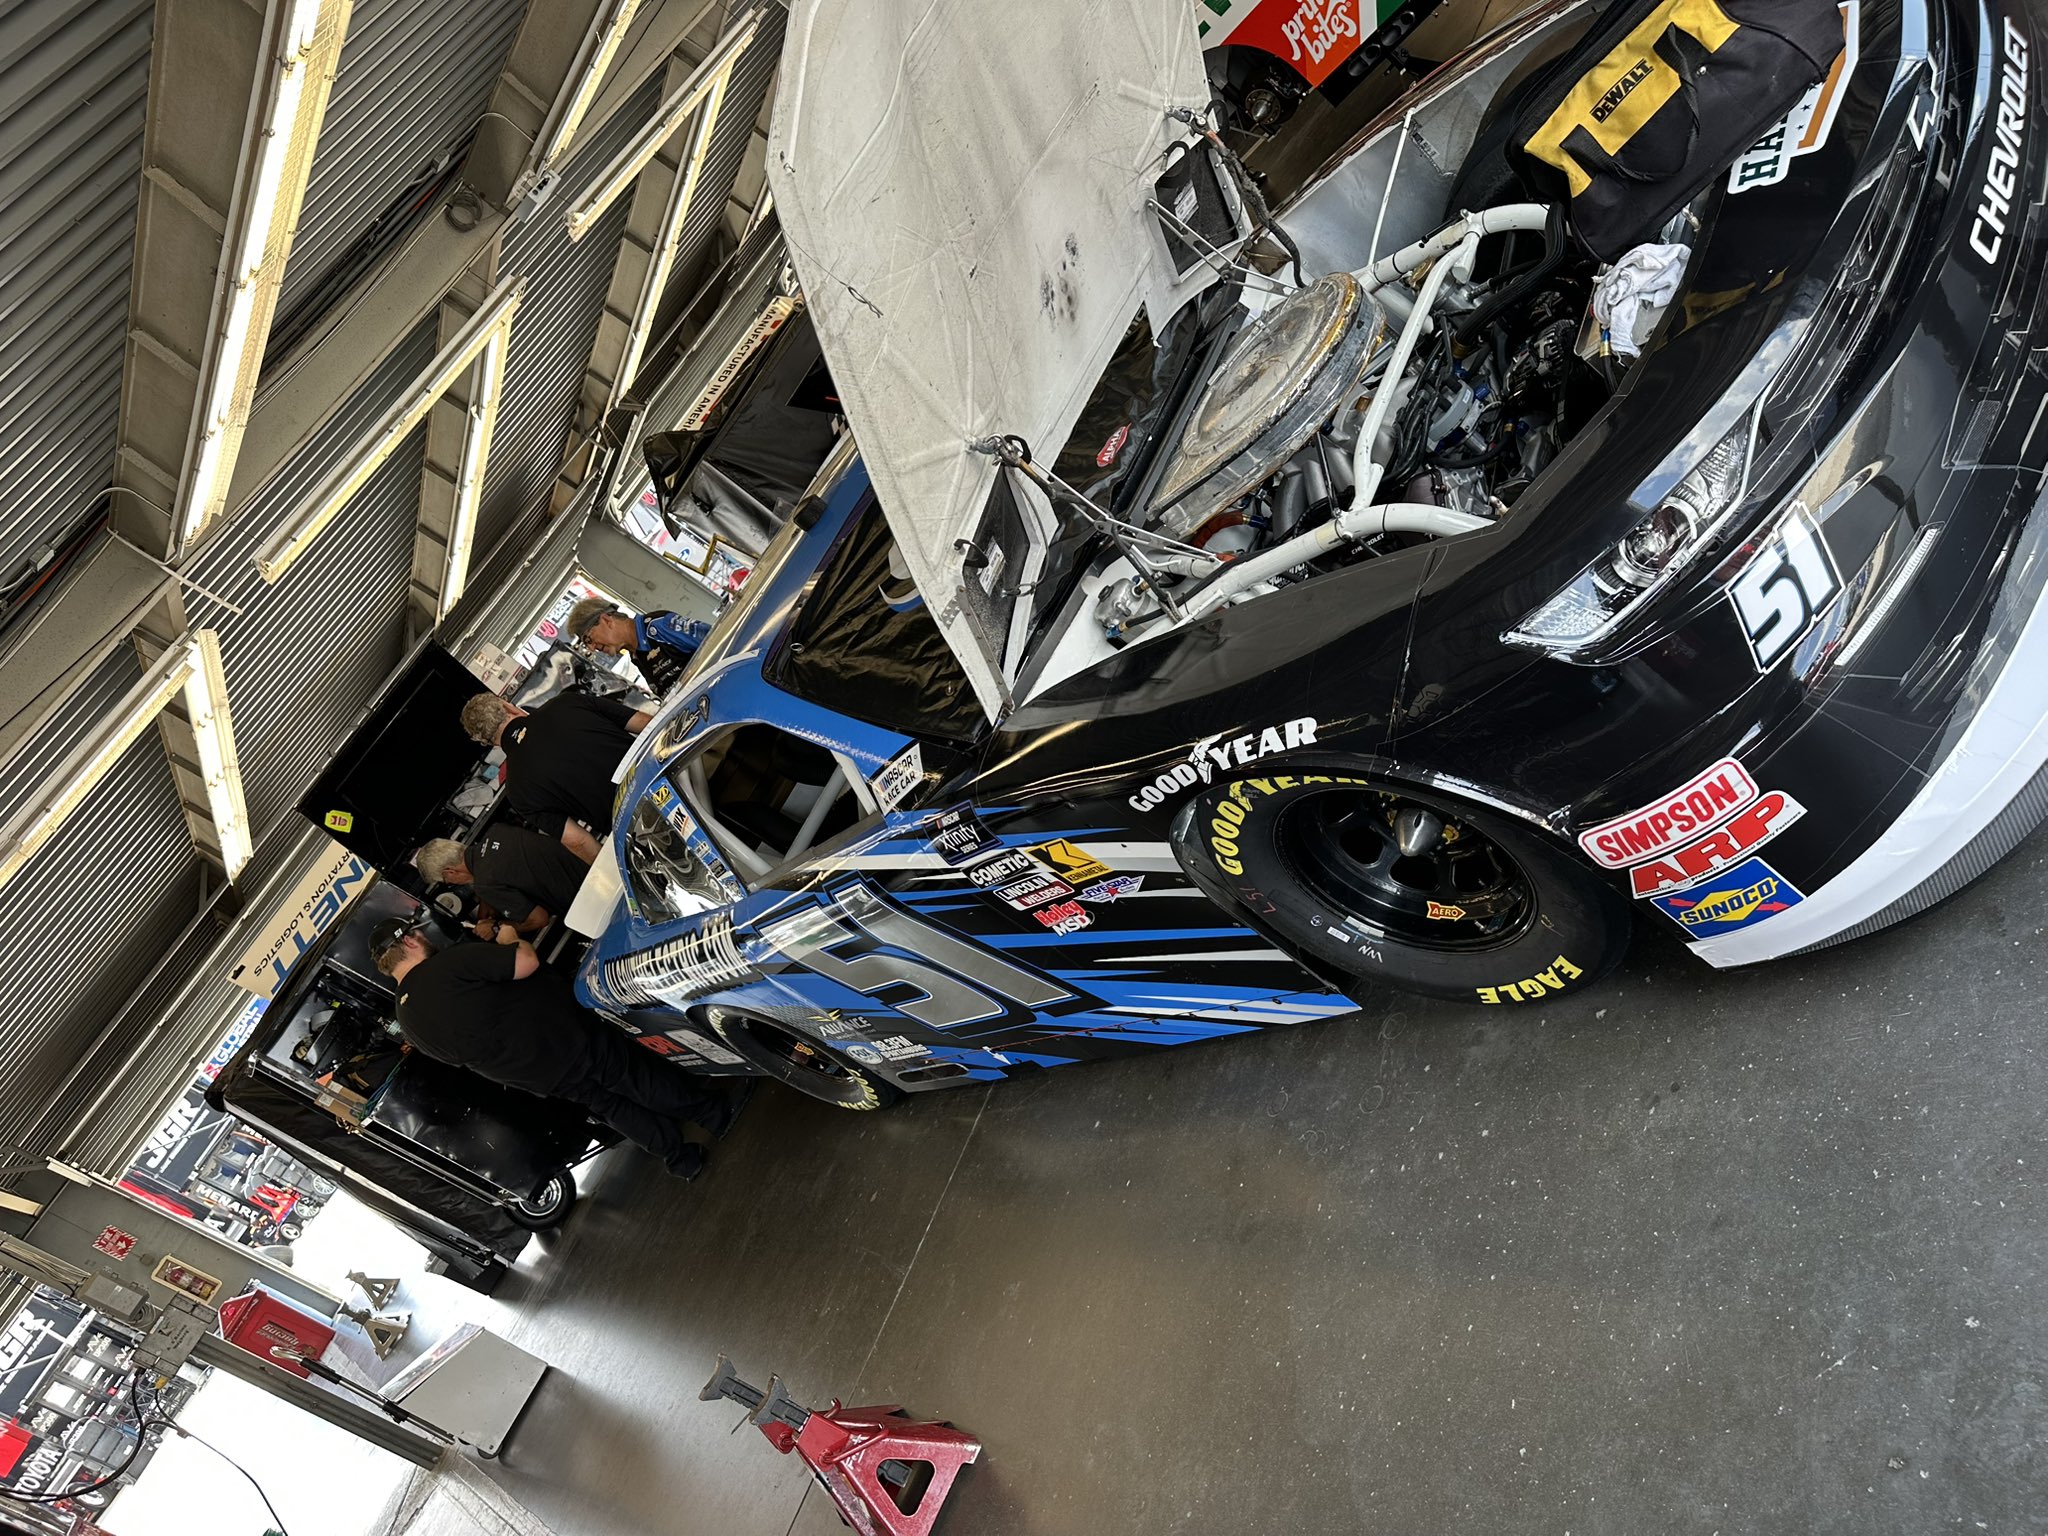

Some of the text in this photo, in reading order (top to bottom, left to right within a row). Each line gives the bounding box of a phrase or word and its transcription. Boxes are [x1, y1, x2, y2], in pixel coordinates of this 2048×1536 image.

[1301, 0, 1358, 64] bites
[1591, 58, 1654, 123] DEWALT
[1737, 114, 1789, 187] HA
[1969, 16, 2032, 265] CHEVROLET
[682, 306, 777, 431] MANUFACTURED IN AMERIC
[1101, 428, 1124, 464] ALPHA
[1351, 532, 1385, 555] CHEROLET
[1732, 510, 1836, 667] 51
[884, 754, 914, 790] NASCAR
[900, 771, 917, 790] CAR
[1599, 772, 1740, 864] SIMPSON
[940, 823, 981, 852] xfinity
[1632, 794, 1785, 894] ARP
[969, 854, 1030, 885] COMETIC
[1068, 865, 1109, 882] KENNAMETAL
[303, 901, 312, 912] &
[998, 877, 1049, 901] LINCOLN
[1021, 886, 1067, 907] WELDERS
[1085, 886, 1106, 899] FIVE
[1683, 879, 1774, 923] SUNOCO
[1033, 900, 1087, 928] Holley
[1053, 914, 1090, 937] MSD
[1431, 906, 1459, 919] AERO
[254, 911, 305, 978] LOGISTICS
[757, 882, 1075, 1029] 51
[1475, 954, 1584, 1005] EAGLE
[216, 1005, 260, 1064] GLOBAL
[818, 1016, 871, 1037] ALLIANCE
[146, 1099, 199, 1169] JGR
[196, 1185, 258, 1223] MENARD
[14, 1447, 63, 1494] TOYOTA
